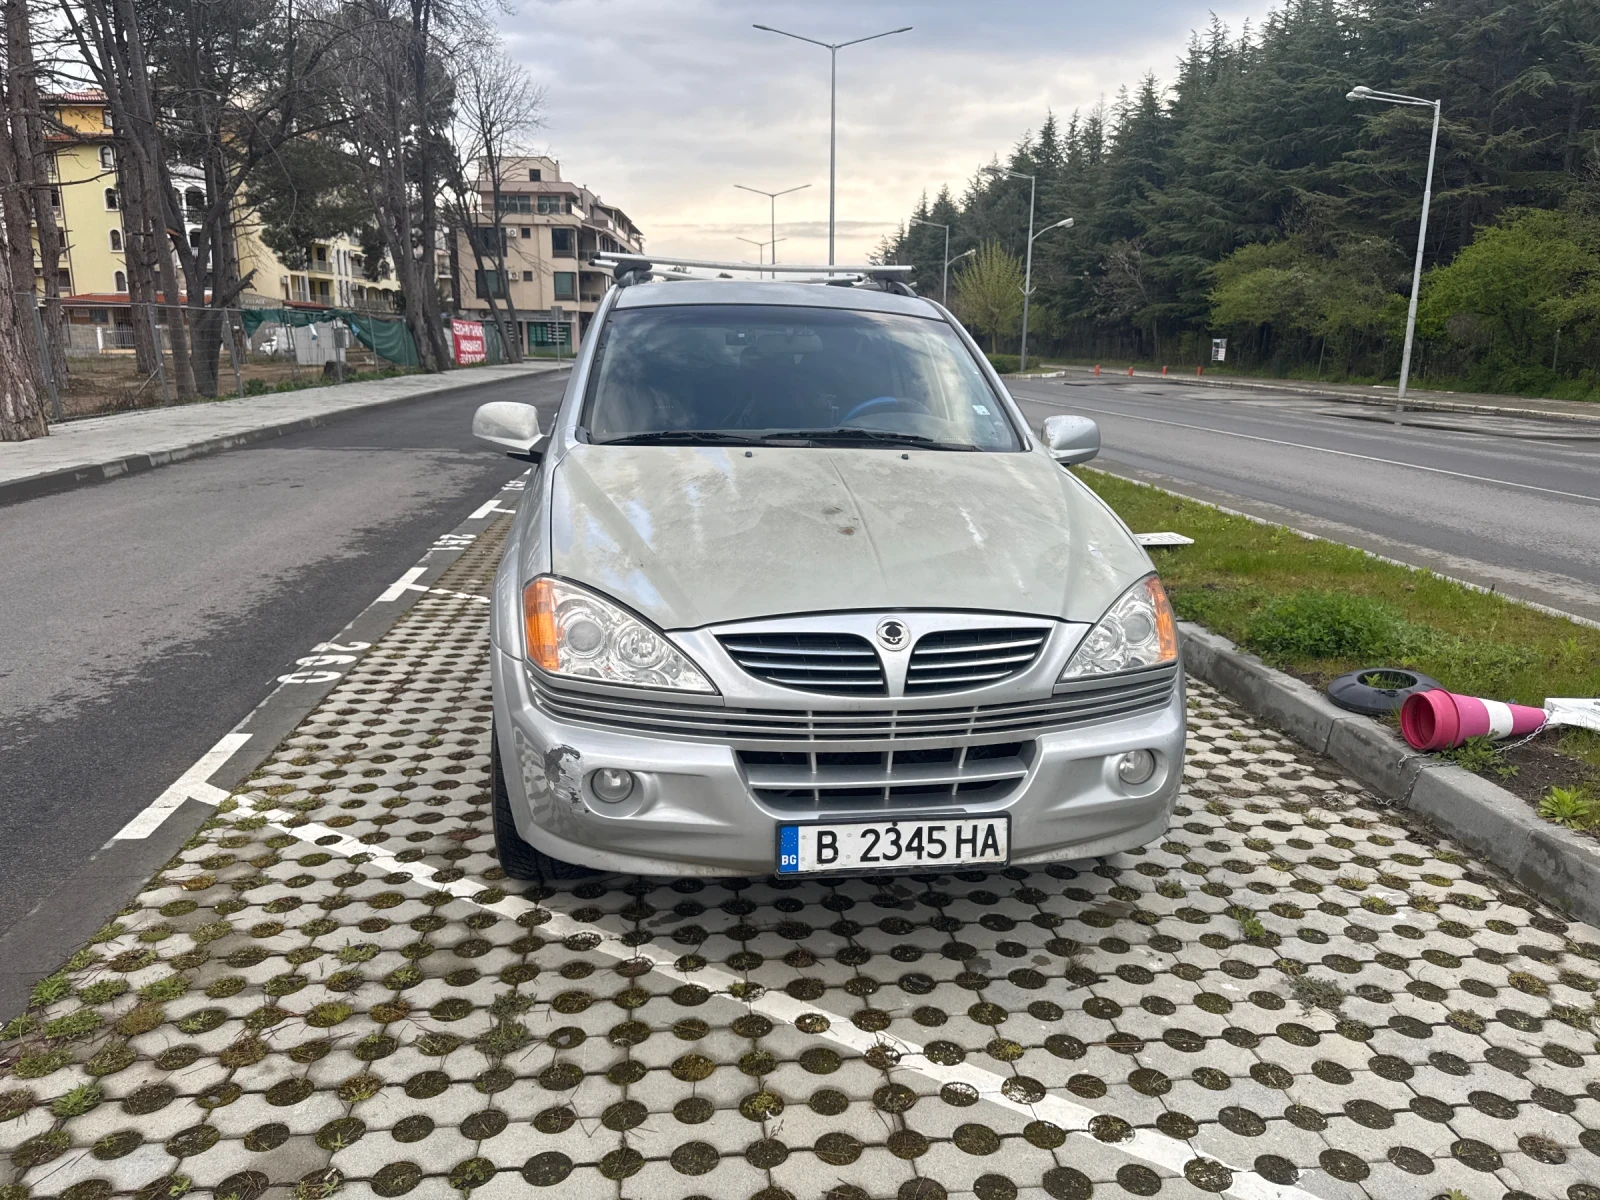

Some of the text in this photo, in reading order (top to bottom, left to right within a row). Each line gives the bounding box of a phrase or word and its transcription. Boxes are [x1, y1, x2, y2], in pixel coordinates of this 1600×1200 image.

[427, 534, 477, 551] 261
[277, 641, 372, 684] 260
[859, 826, 947, 862] 2345
[781, 854, 797, 866] BG
